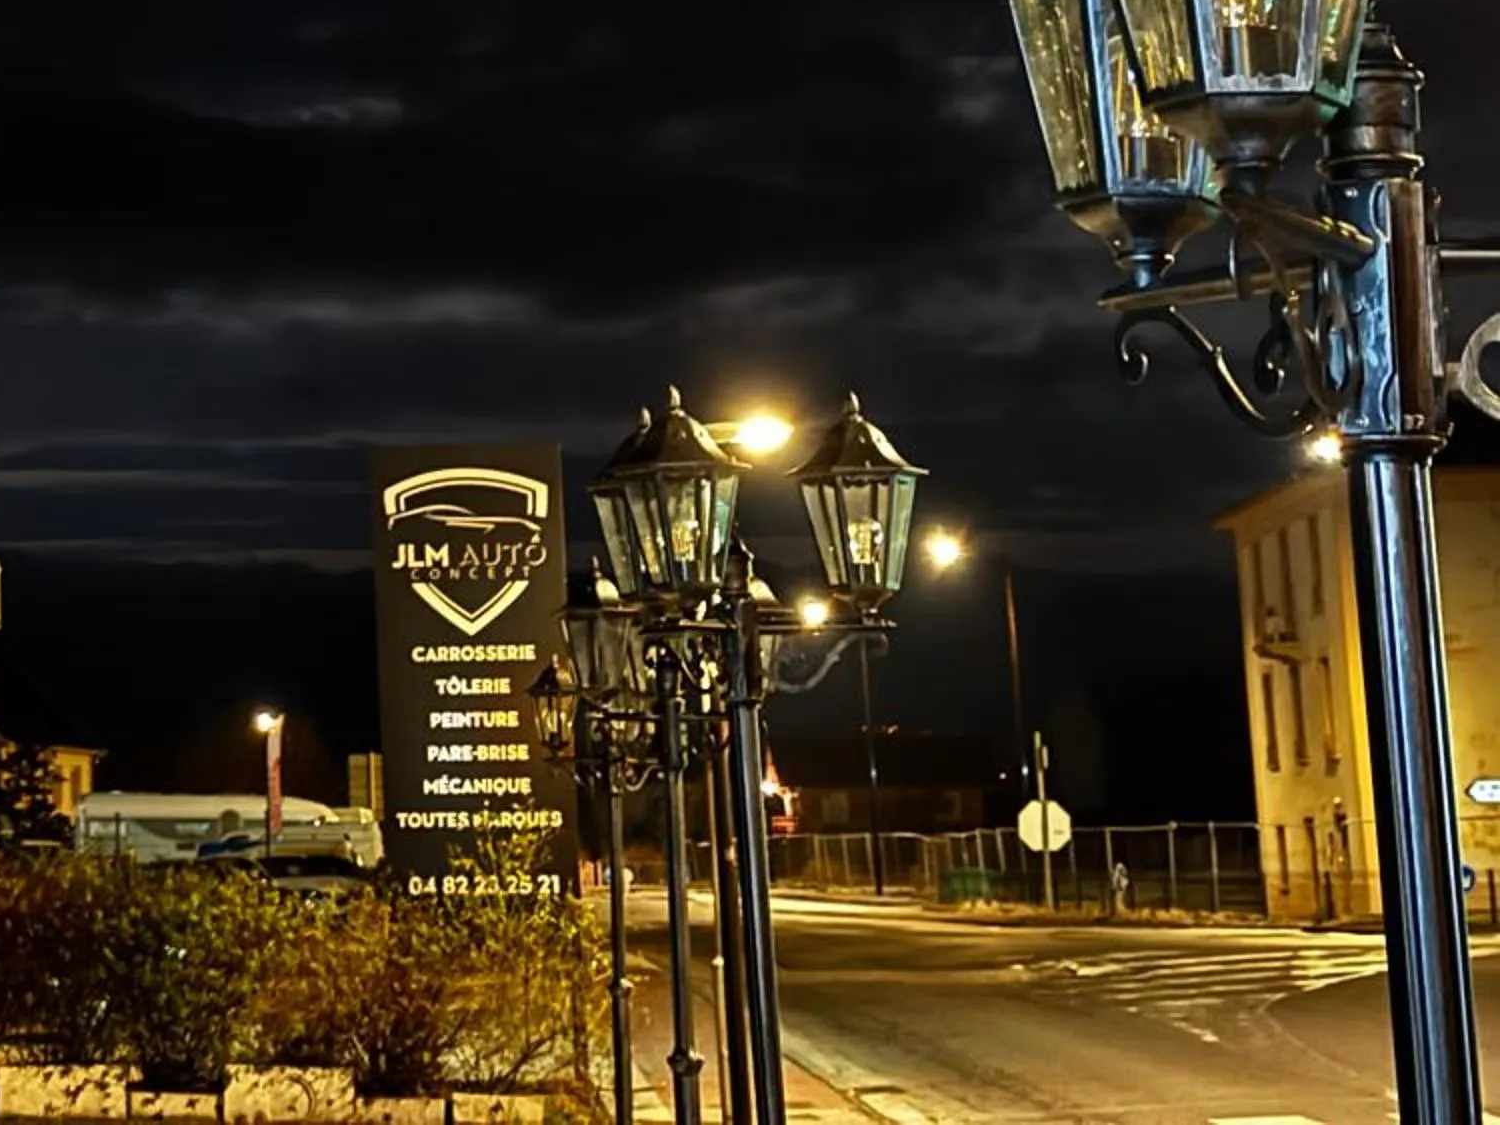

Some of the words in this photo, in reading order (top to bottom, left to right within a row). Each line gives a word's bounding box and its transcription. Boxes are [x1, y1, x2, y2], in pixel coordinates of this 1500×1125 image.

[391, 542, 450, 569] JLM
[458, 542, 548, 567] AUTO
[410, 565, 531, 581] CONCEPT
[411, 643, 537, 663] CARROSSERIE
[434, 674, 511, 696] TÔLERIE
[429, 710, 519, 729] PEINTURE
[426, 743, 530, 763] PARE-BRISE
[422, 773, 532, 797] MÉCANIQUE
[395, 810, 470, 829] TOUTES
[408, 876, 438, 896] 04
[442, 876, 469, 895] 82
[537, 875, 562, 895] 21
